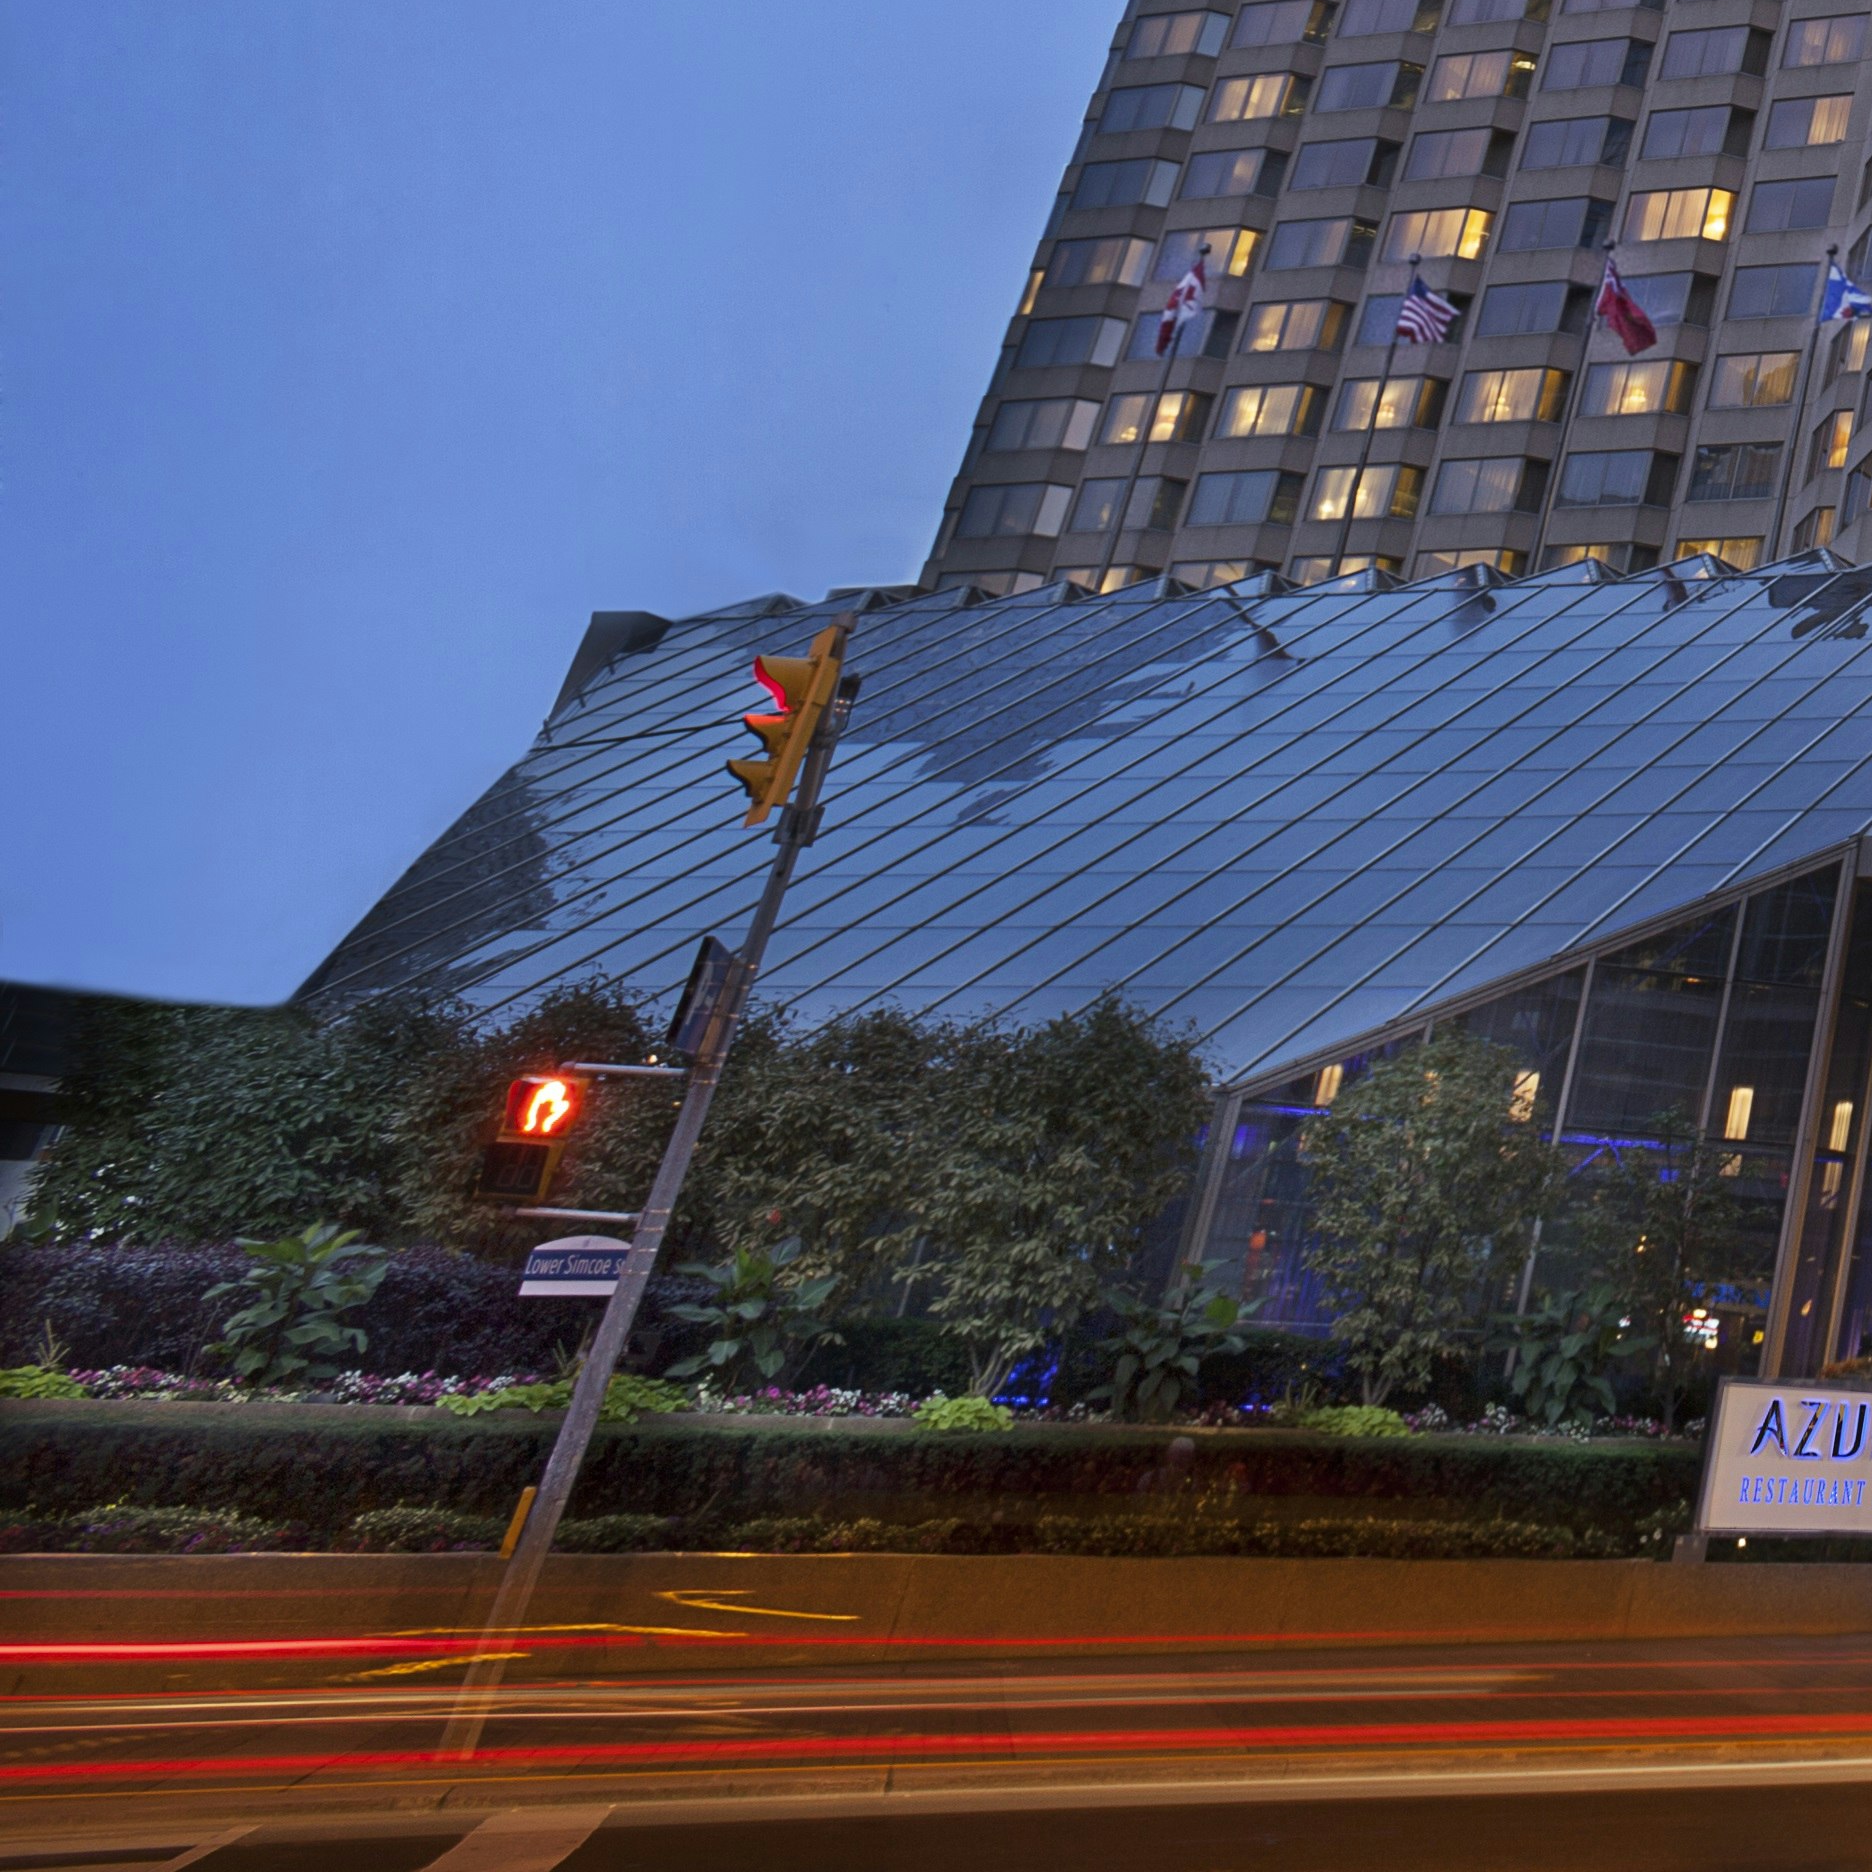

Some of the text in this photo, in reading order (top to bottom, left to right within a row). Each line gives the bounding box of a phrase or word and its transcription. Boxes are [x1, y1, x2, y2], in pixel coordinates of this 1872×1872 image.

[525, 1254, 565, 1275] Lower
[563, 1254, 612, 1275] Simcoe
[1738, 1477, 1866, 1507] RESTAURANT
